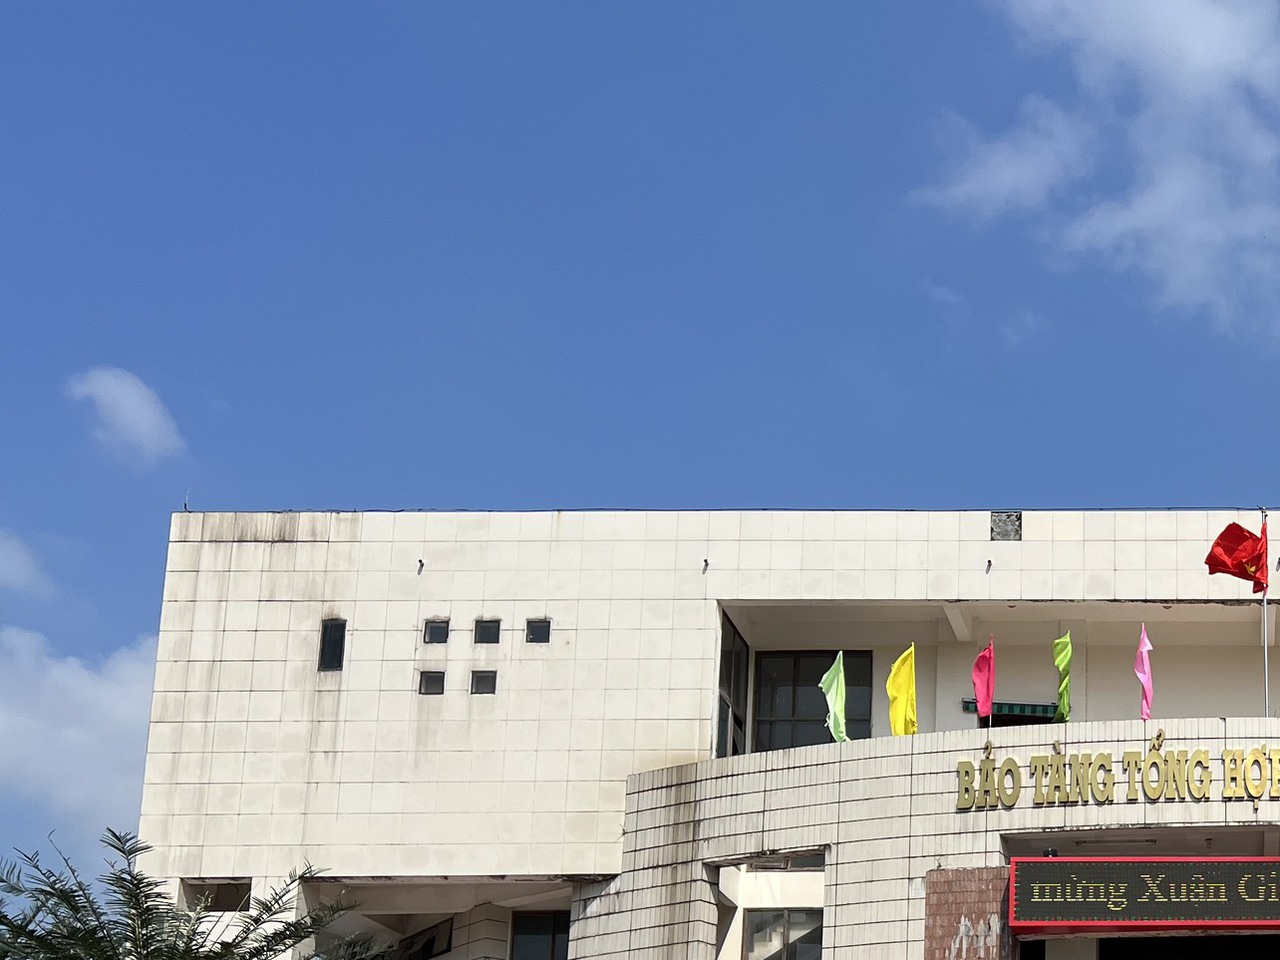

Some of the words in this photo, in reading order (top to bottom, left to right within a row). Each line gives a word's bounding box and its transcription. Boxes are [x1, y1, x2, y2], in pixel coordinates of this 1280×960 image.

[956, 740, 1021, 809] BẢO
[1029, 740, 1115, 804] TÀNG
[1122, 728, 1212, 801] TỔNG
[1137, 873, 1228, 902] Xuân
